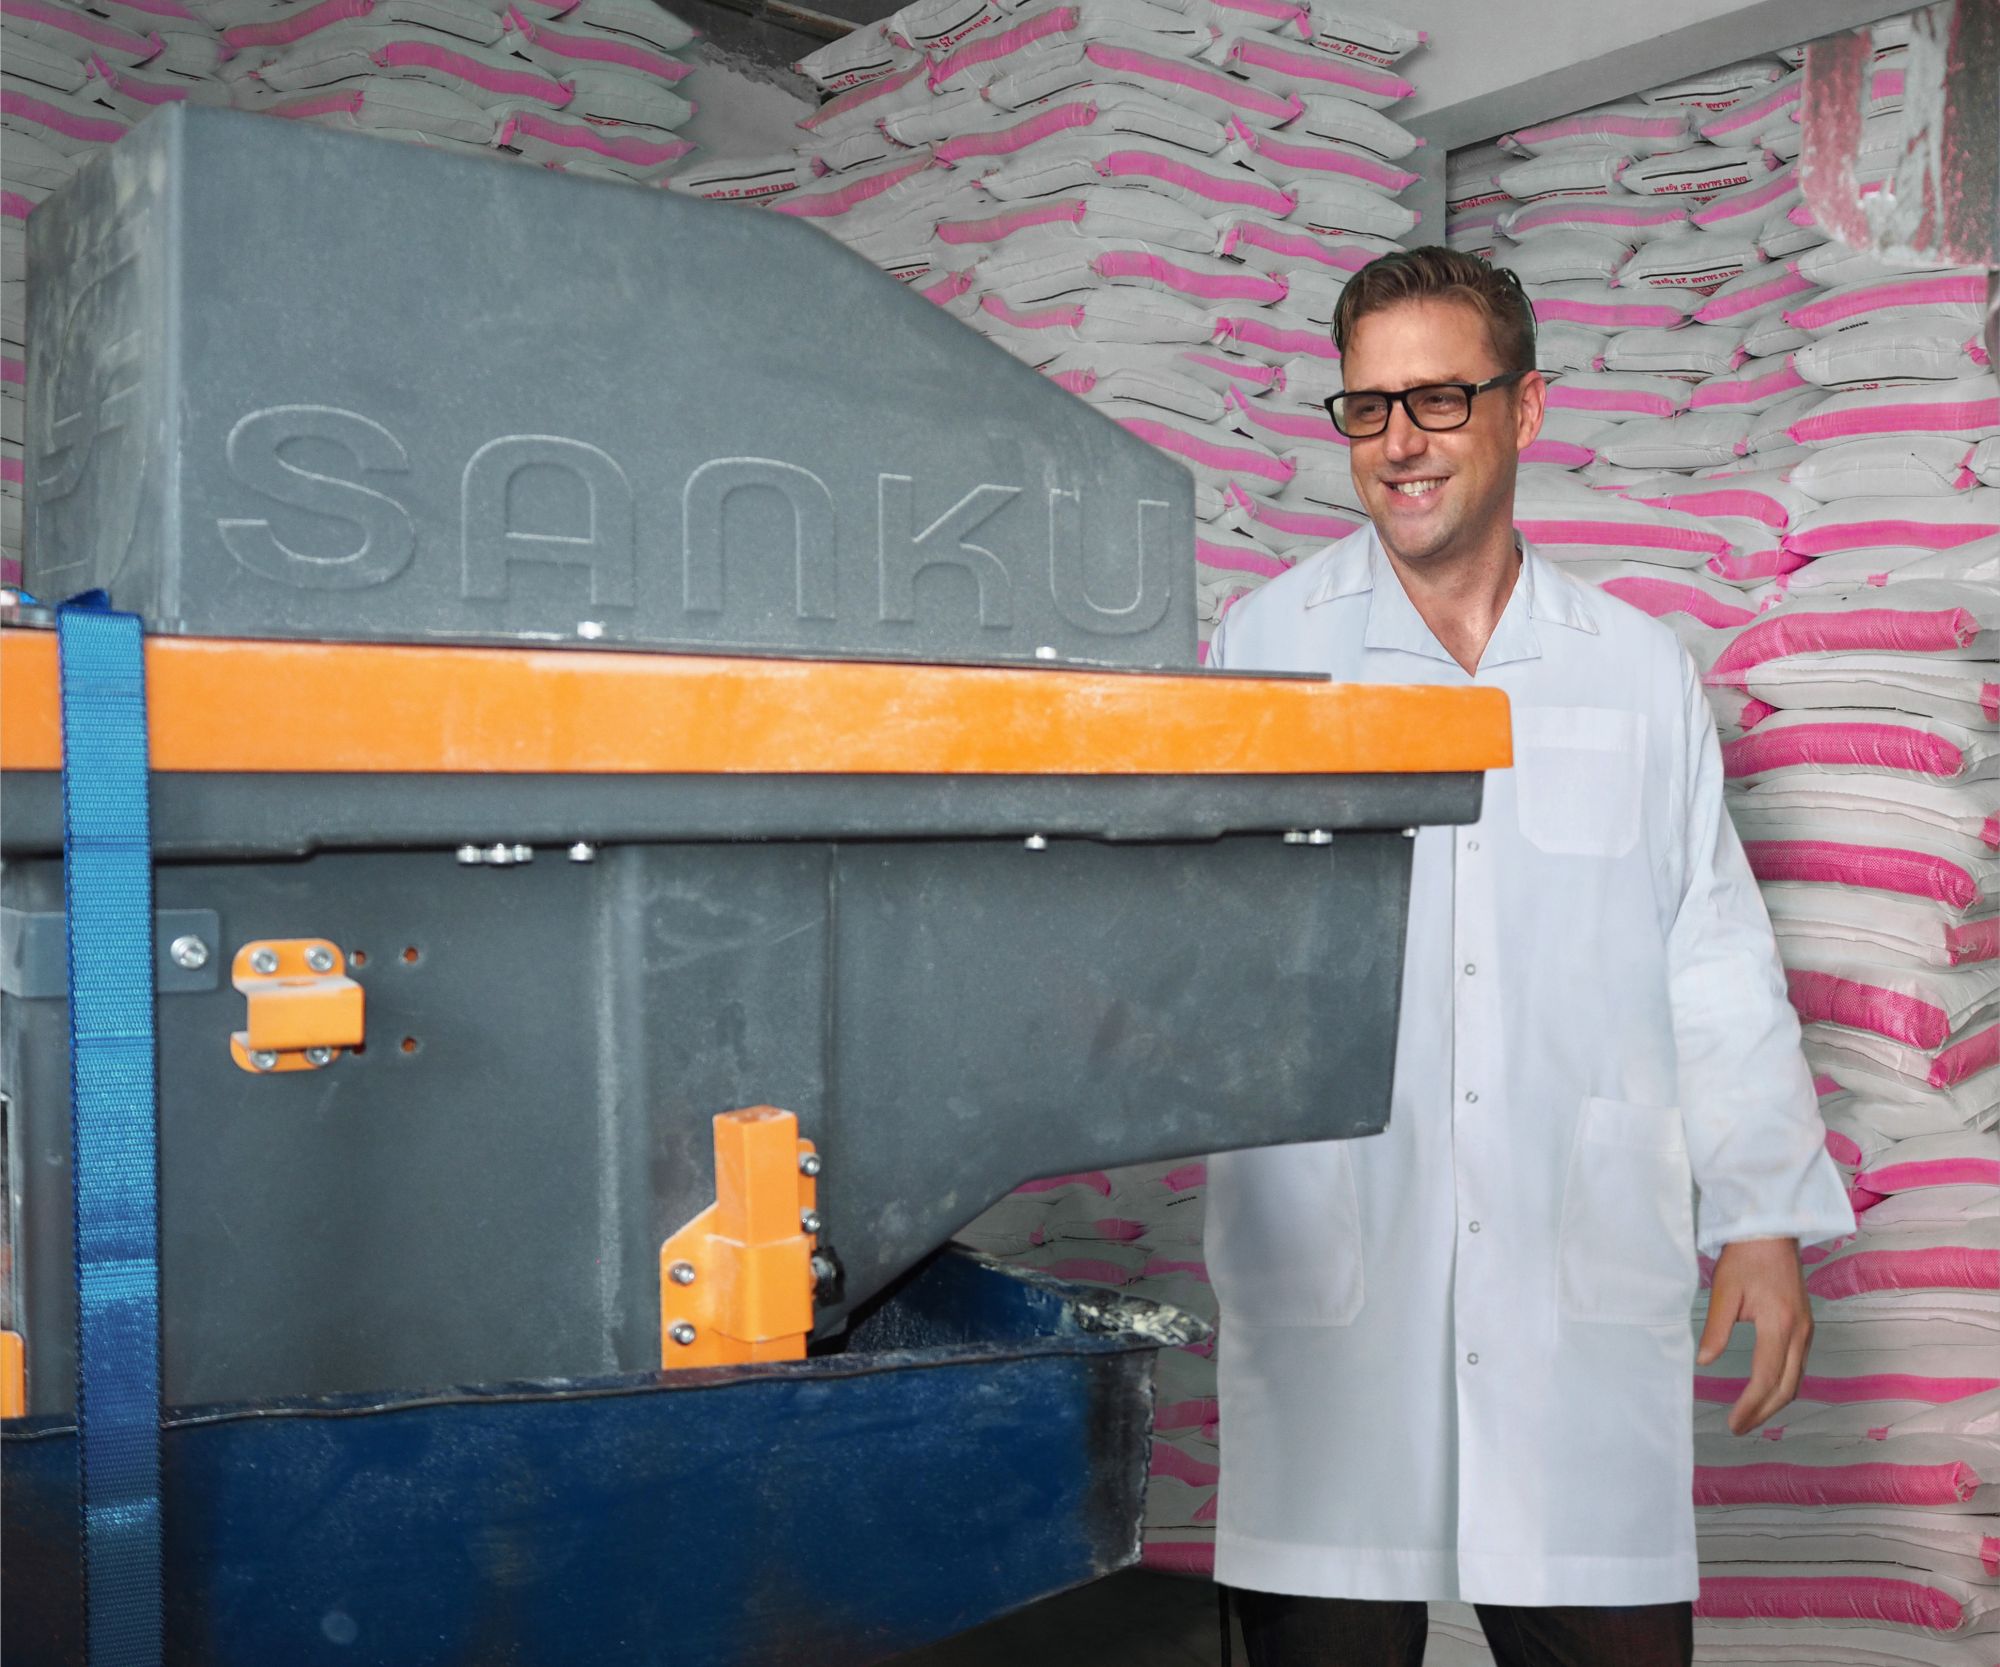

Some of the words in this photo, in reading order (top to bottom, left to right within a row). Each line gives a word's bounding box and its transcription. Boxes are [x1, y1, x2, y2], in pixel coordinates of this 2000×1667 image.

[939, 35, 954, 49] 25
[1343, 44, 1359, 56] 25
[845, 73, 859, 86] 25
[1680, 182, 1693, 191] 25
[1695, 179, 1723, 190] SALAAM
[1722, 177, 1732, 185] ES
[728, 188, 740, 198] 25
[1675, 276, 1688, 285] 25
[215, 404, 1172, 635] SANKU
